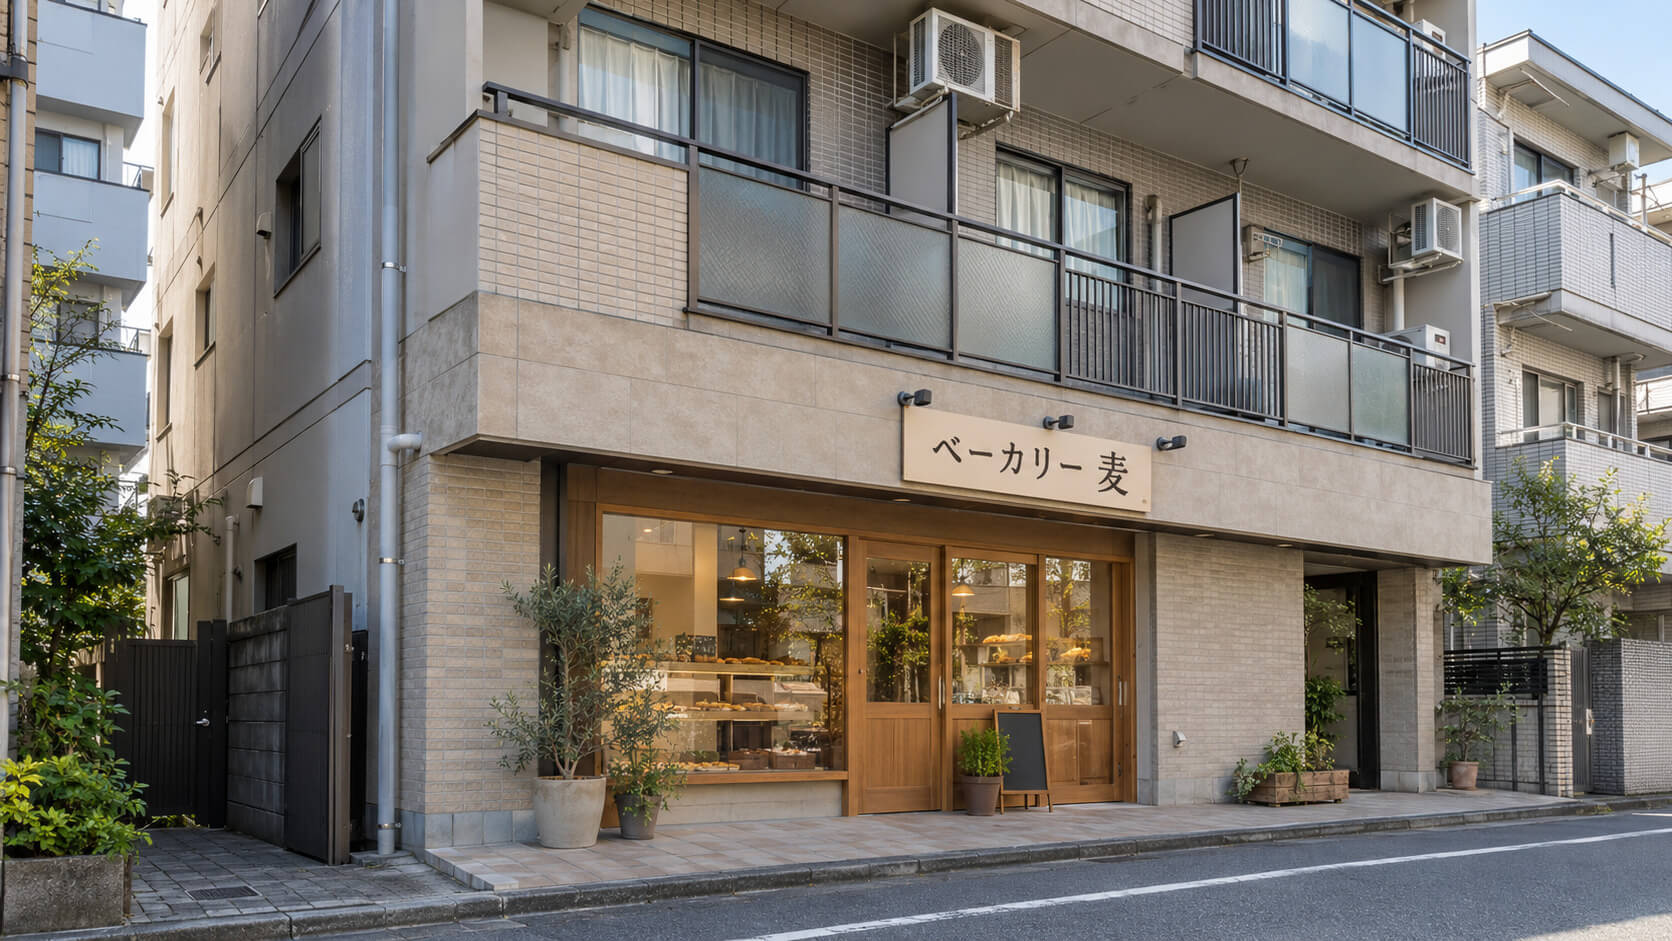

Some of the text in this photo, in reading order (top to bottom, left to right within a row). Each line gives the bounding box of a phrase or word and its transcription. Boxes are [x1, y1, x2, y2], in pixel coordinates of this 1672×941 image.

[932, 436, 1129, 496] ベーカリー 麦
